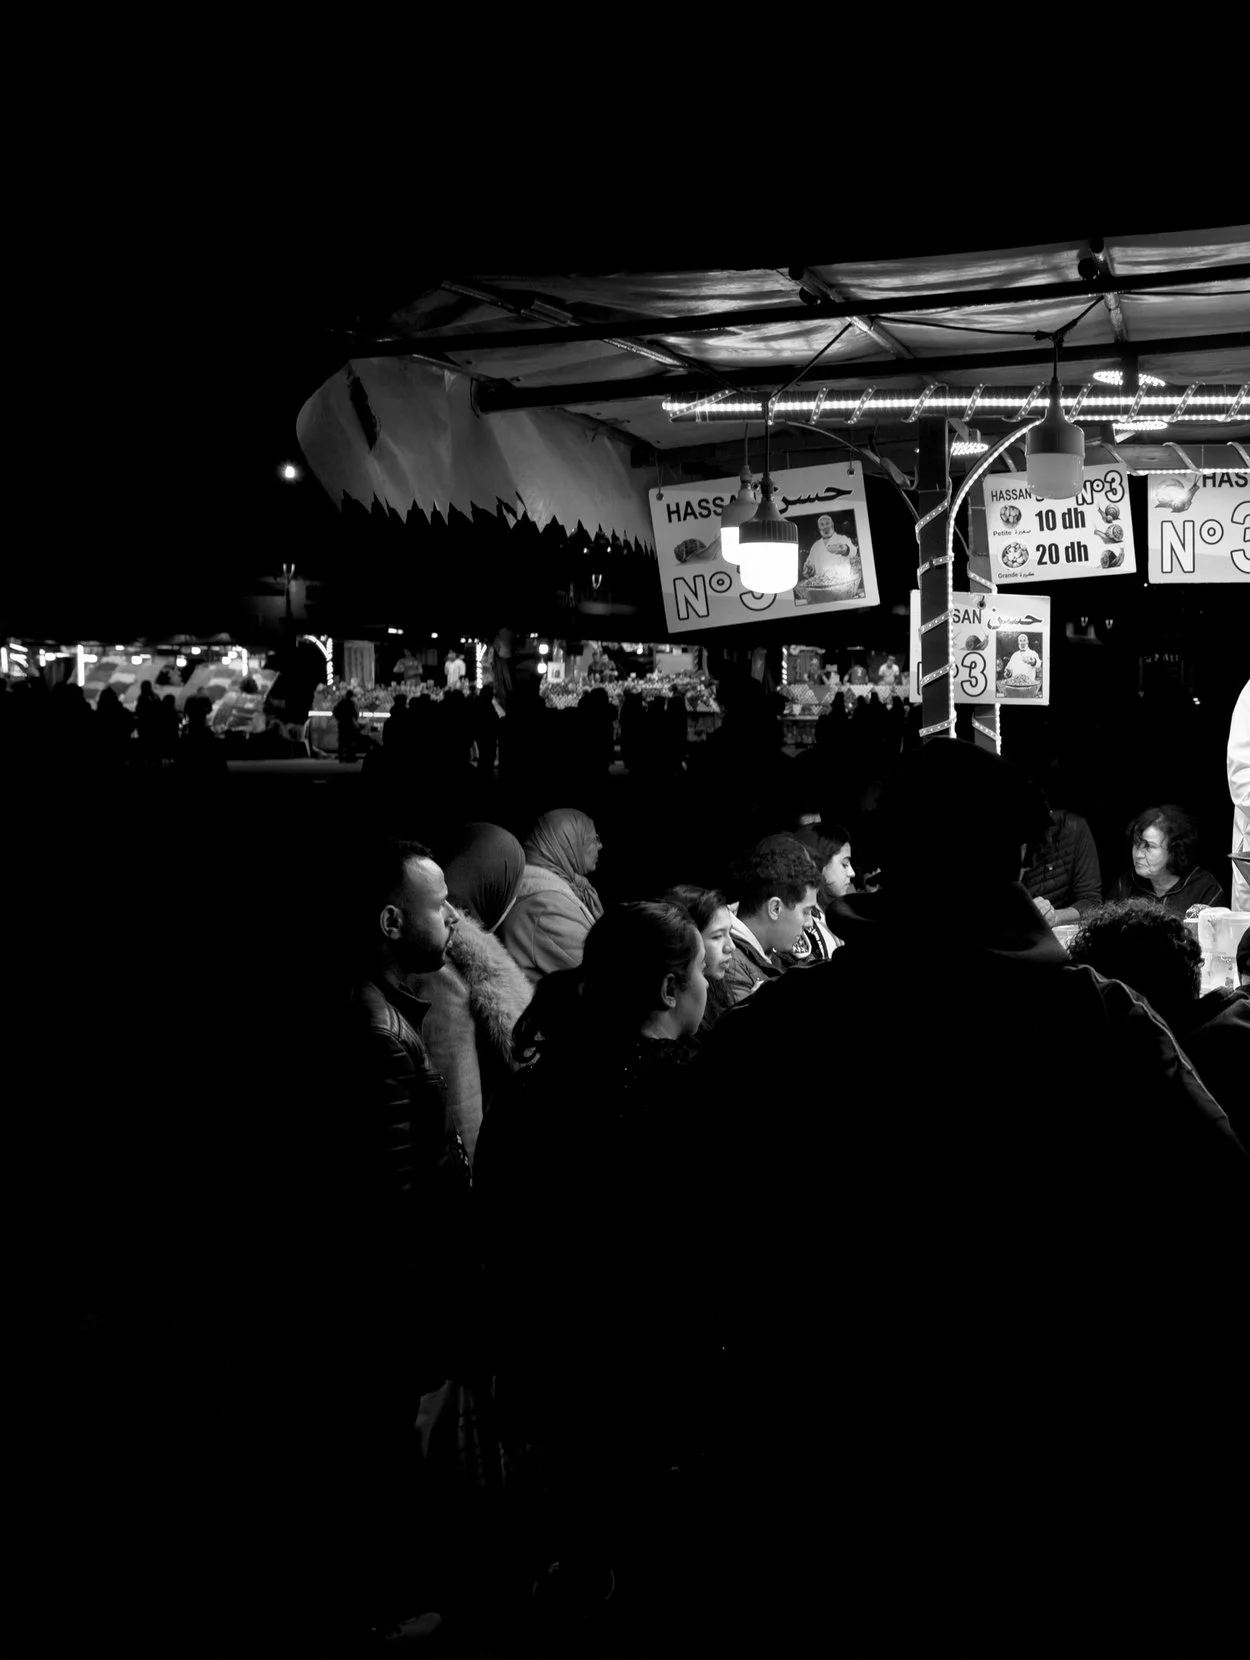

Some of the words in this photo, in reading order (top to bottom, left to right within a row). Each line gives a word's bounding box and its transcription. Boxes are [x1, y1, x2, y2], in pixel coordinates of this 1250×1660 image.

[666, 493, 745, 522] HASS
[991, 488, 1032, 502] HASSAN
[1035, 509, 1057, 532] 10
[1061, 507, 1086, 530] dh
[1036, 543, 1060, 566] 20
[1064, 541, 1089, 564] dh
[987, 608, 1042, 629] حسن
